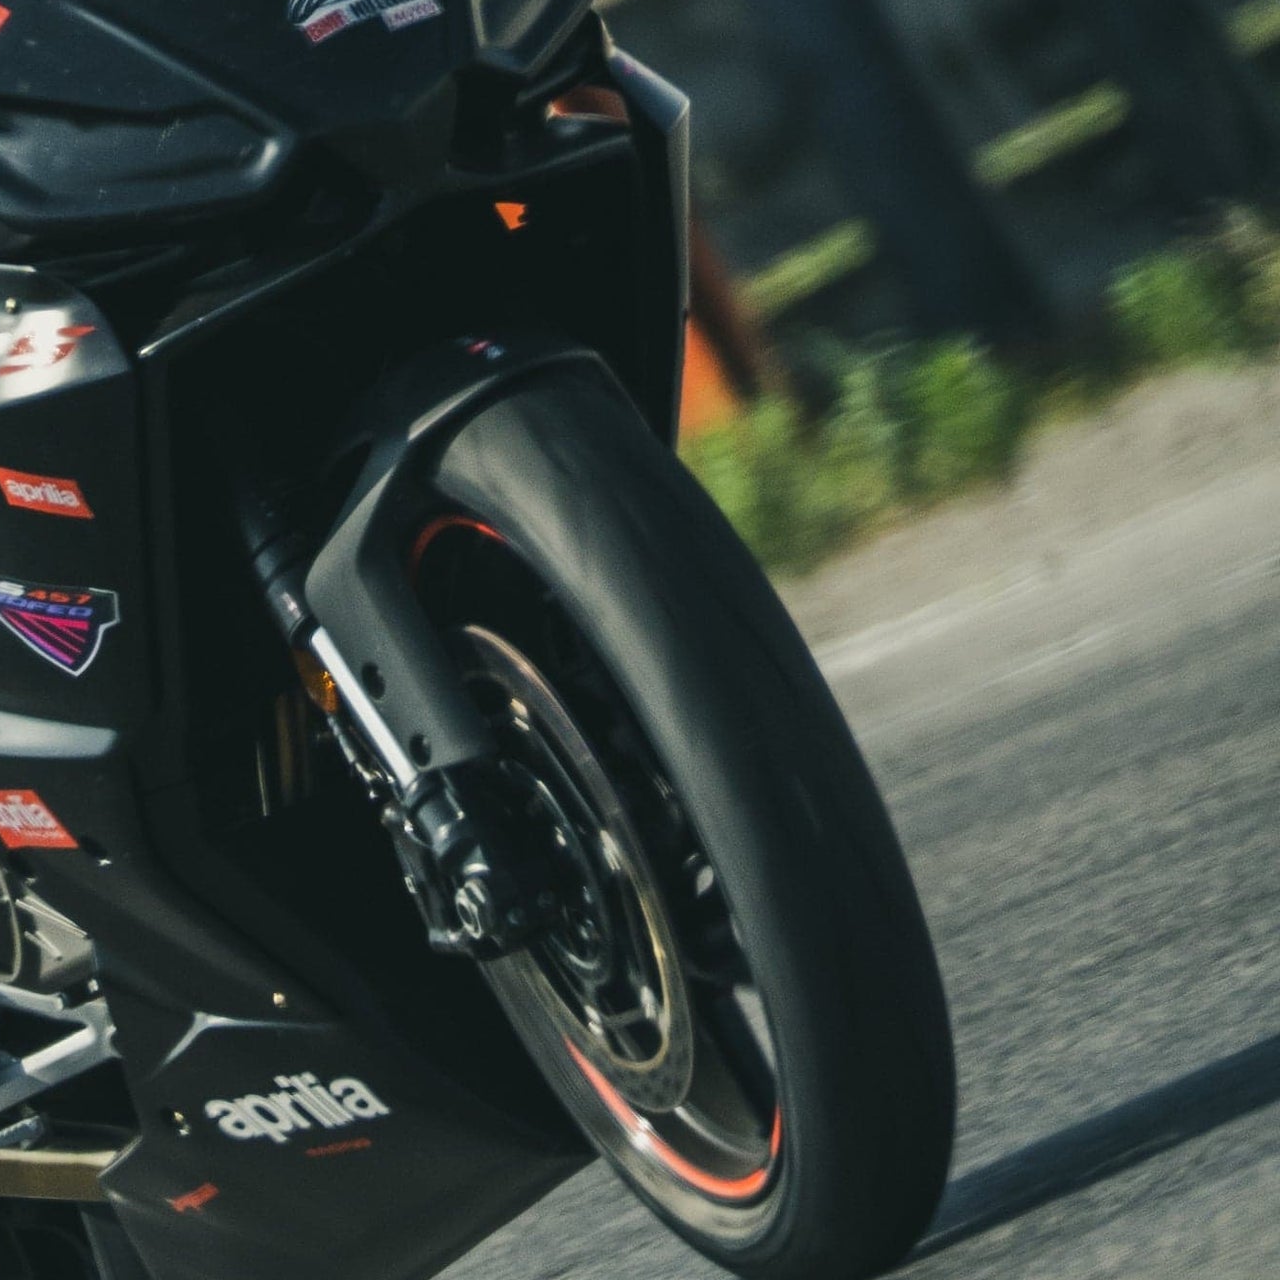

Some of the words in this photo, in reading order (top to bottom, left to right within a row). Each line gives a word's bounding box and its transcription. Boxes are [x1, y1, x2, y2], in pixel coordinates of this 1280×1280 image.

[5, 479, 81, 508] aprilia
[26, 588, 92, 605] 457
[204, 1071, 390, 1144] aprilia
